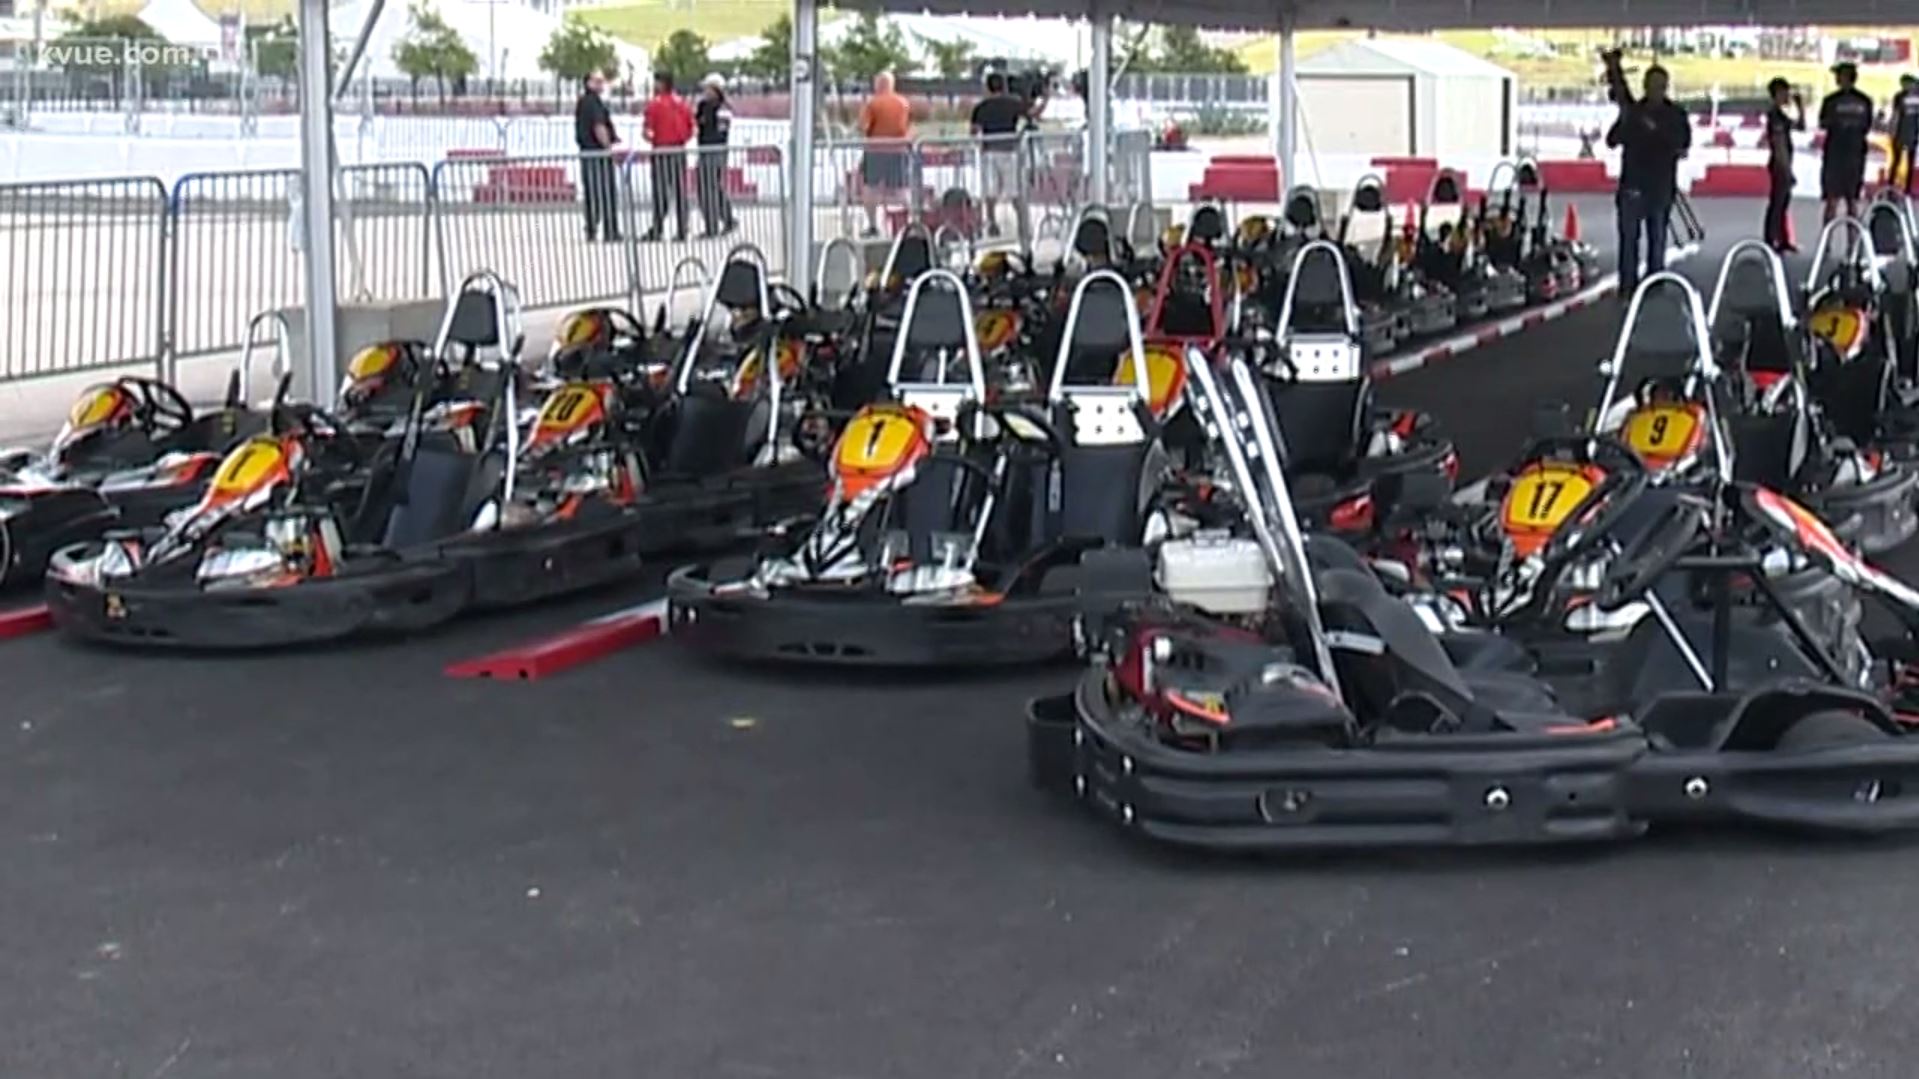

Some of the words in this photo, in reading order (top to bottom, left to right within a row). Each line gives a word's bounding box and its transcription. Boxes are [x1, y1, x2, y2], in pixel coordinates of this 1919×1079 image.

[543, 391, 585, 421] 20
[867, 420, 886, 457] 1
[1649, 415, 1668, 446] 9
[1528, 481, 1566, 519] 17
